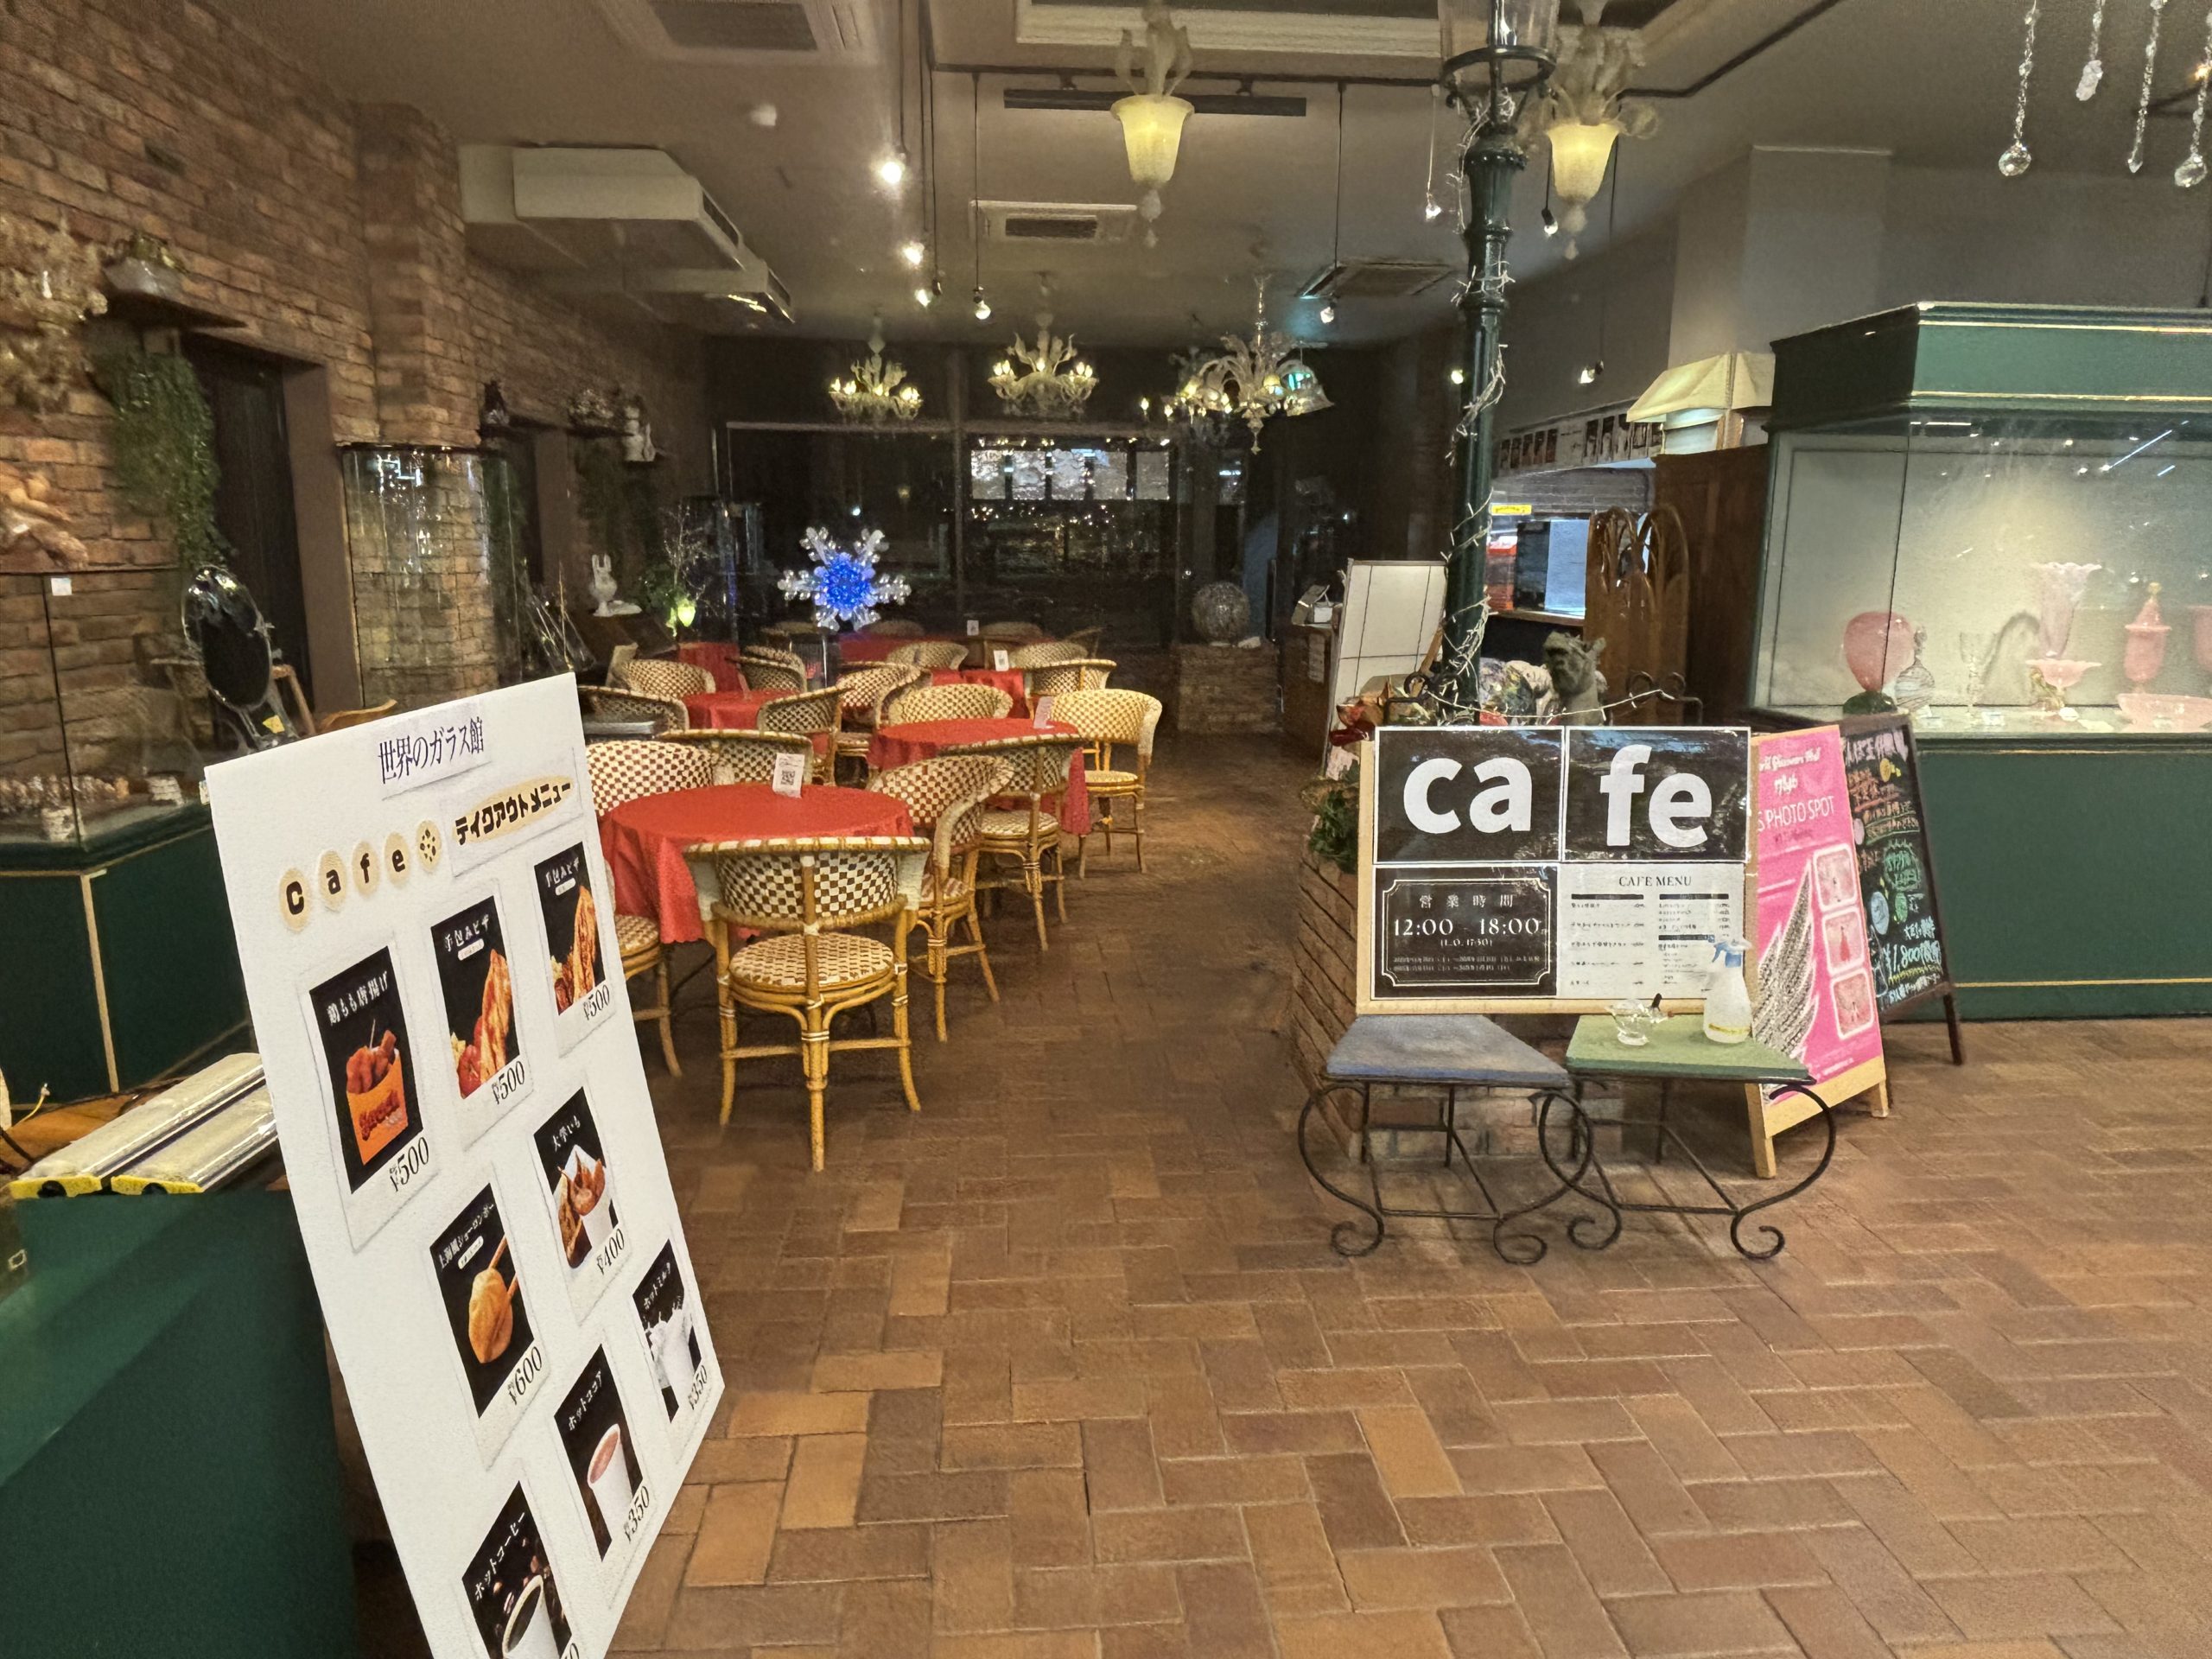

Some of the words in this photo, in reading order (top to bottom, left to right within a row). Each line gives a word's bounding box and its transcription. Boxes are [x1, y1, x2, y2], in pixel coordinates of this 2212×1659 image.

[378, 716, 485, 784] 世界のガラス館
[454, 782, 572, 845] テイクアウトメニュー
[1765, 802, 1807, 830] PHOTO
[1808, 796, 1834, 821] SPOT
[1419, 893, 1514, 908] 営業時間
[1656, 875, 1692, 887] MENU
[1394, 918, 1453, 936] 12:00
[1479, 918, 1540, 935] 18:00
[390, 1136, 429, 1192] ¥500
[568, 1369, 602, 1431] ホットココア
[474, 1512, 525, 1602] ホットコーヒー
